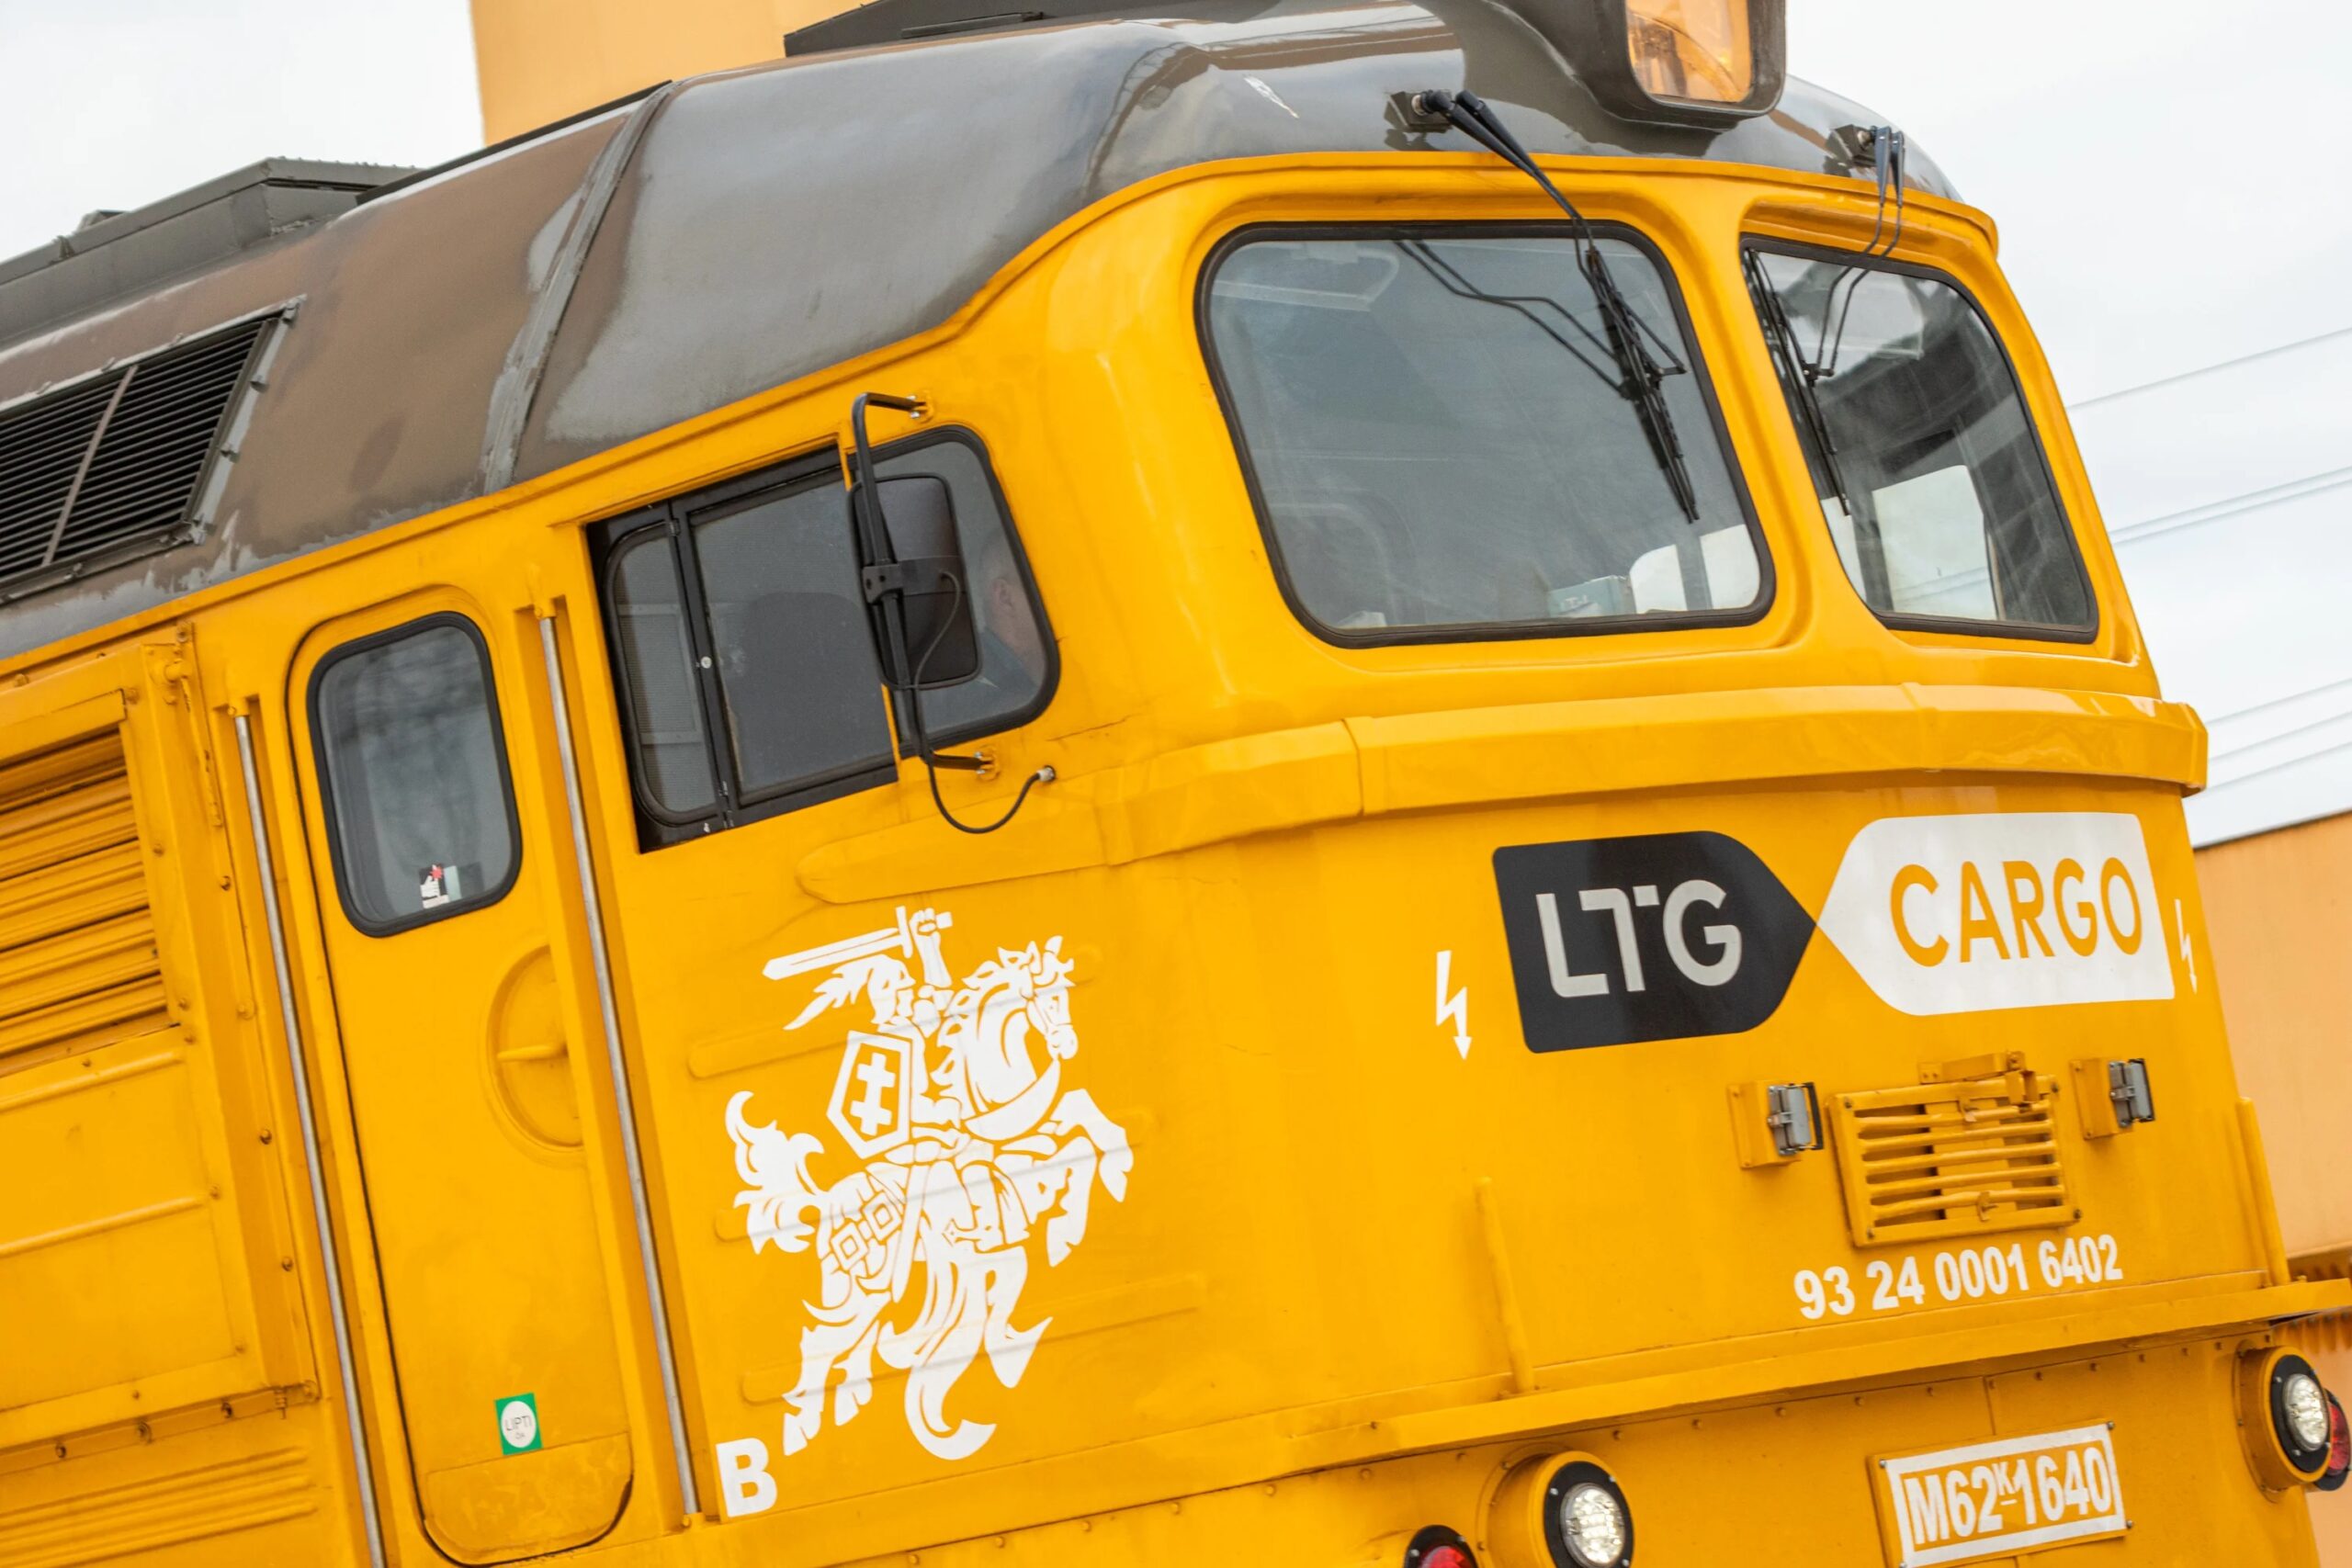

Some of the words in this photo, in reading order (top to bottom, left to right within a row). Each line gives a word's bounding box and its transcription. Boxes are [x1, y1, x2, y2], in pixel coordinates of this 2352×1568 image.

[1537, 879, 1741, 998] LTG
[1891, 856, 2143, 967] CARGO
[1794, 1266, 1855, 1319] 93
[1866, 1257, 1925, 1310] 24
[1934, 1243, 2029, 1301] 0001
[2038, 1234, 2123, 1288] 6402
[716, 1437, 777, 1517] B
